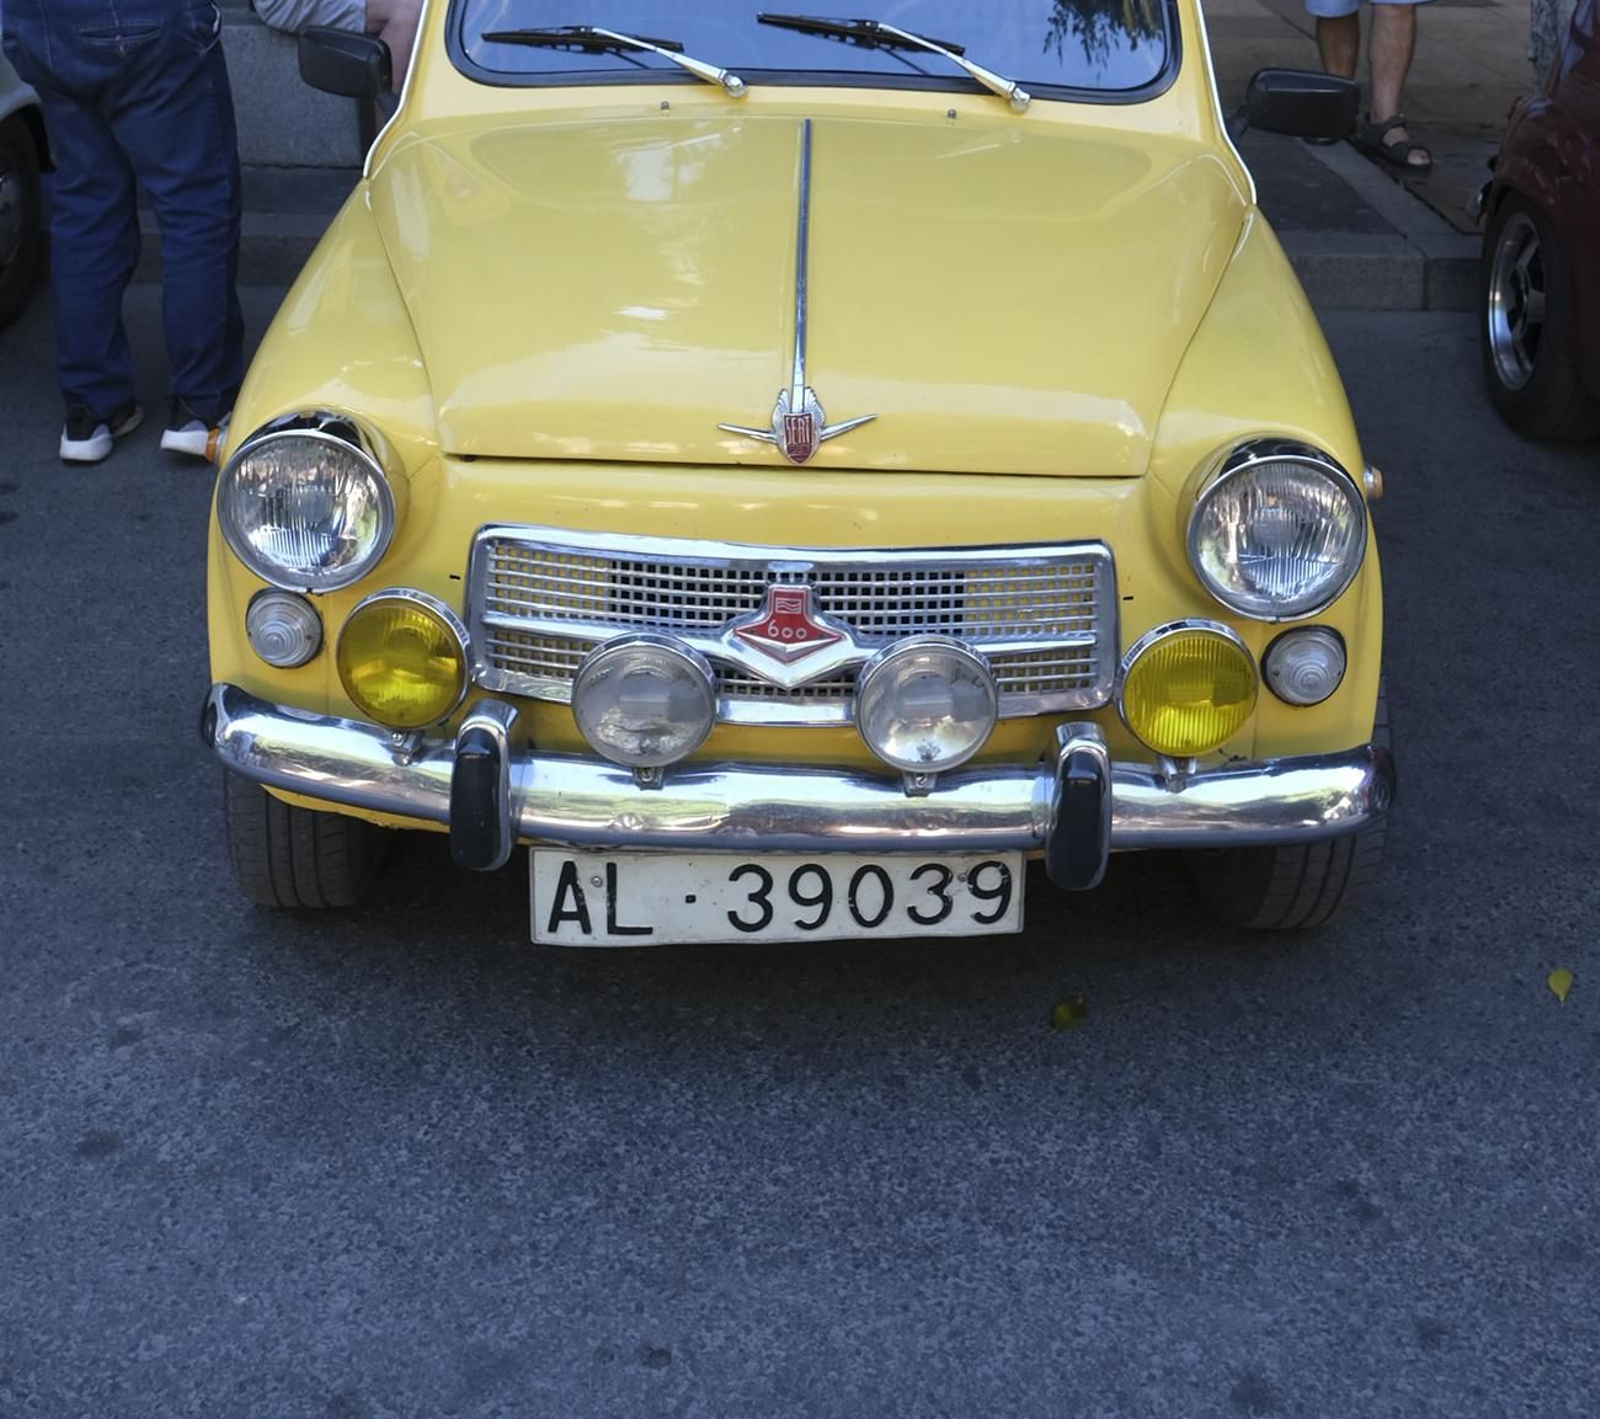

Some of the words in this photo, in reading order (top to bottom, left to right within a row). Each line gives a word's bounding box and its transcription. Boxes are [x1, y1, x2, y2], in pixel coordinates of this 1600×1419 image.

[785, 415, 811, 445] SEAT
[767, 619, 808, 640] 600
[547, 860, 654, 935] AL
[726, 859, 1013, 933] 39039
